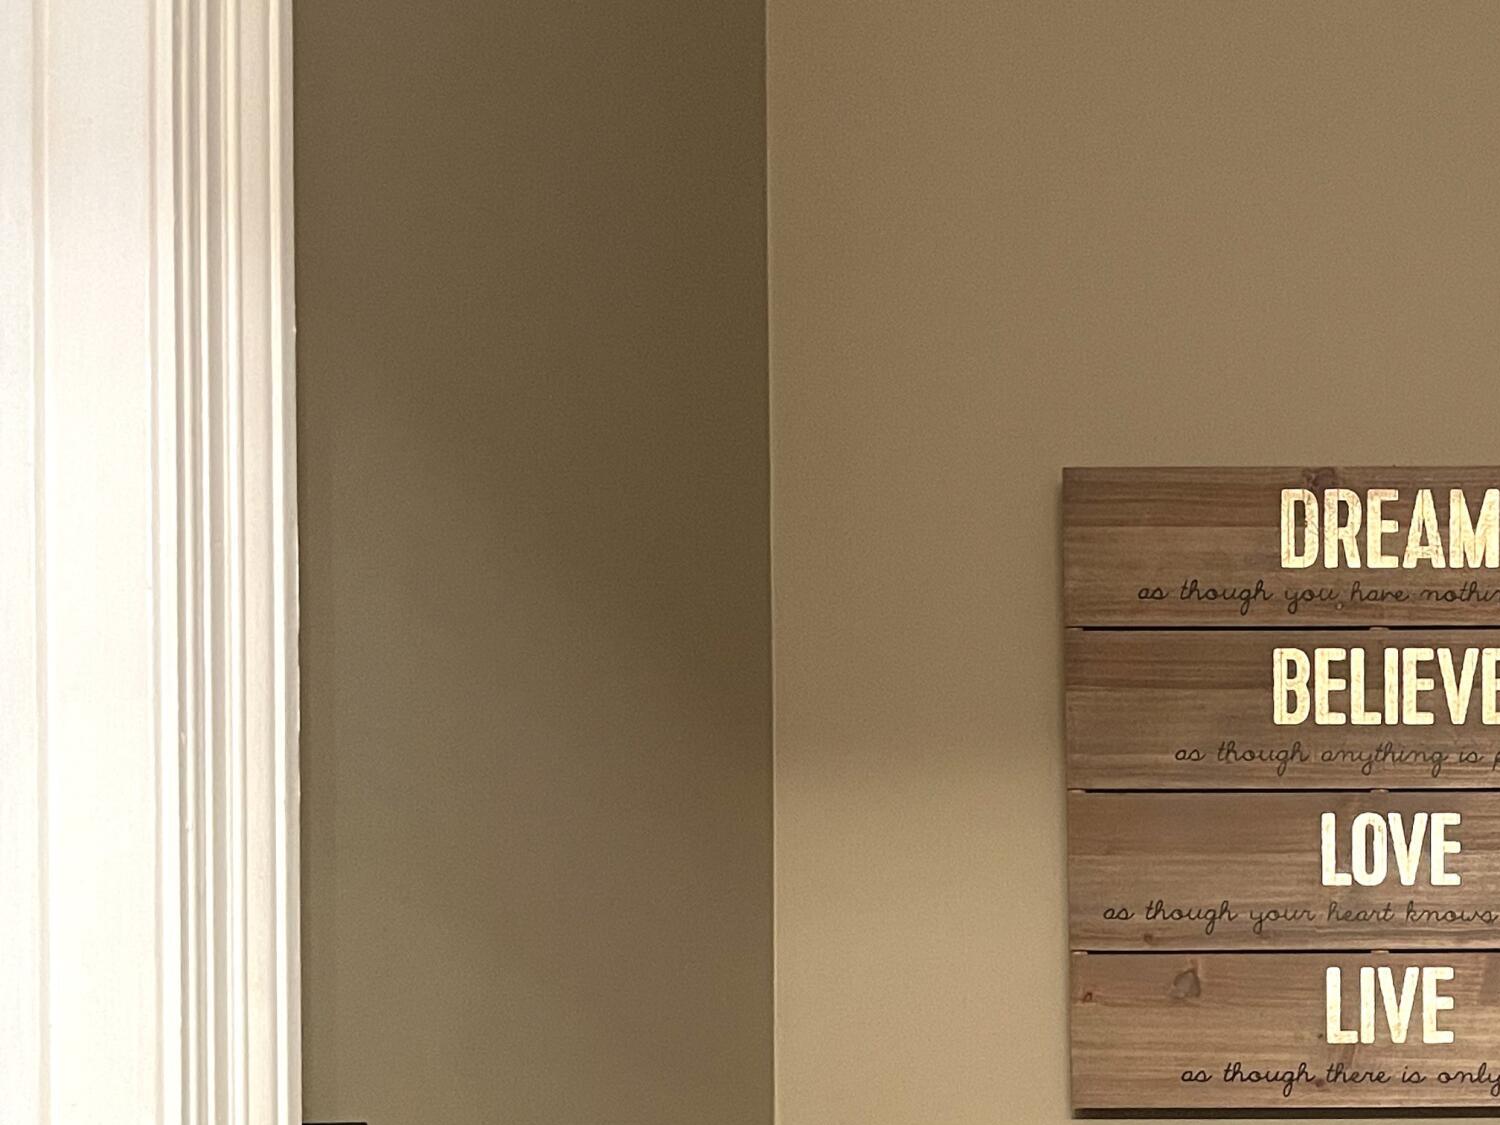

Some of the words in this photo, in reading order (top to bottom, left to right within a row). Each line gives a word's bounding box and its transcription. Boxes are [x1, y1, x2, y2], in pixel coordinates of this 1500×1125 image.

[1280, 488, 1500, 569] DREAM
[1138, 585, 1169, 600] as
[1179, 579, 1274, 615] though
[1285, 585, 1337, 614] you
[1350, 579, 1408, 603] have
[1174, 747, 1205, 763] as
[1216, 741, 1310, 777] though
[1320, 741, 1449, 777] anything
[1458, 744, 1483, 764] is
[1320, 811, 1462, 887] LOVE
[1102, 906, 1135, 922] as
[1144, 899, 1238, 934] though
[1248, 906, 1315, 934] your
[1327, 900, 1395, 923] heart
[1404, 899, 1499, 924] knows
[1326, 966, 1455, 1045] LIVE
[1181, 1068, 1213, 1083] as
[1223, 1062, 1315, 1097] though
[1326, 1062, 1391, 1084] there
[1401, 1065, 1426, 1084] is
